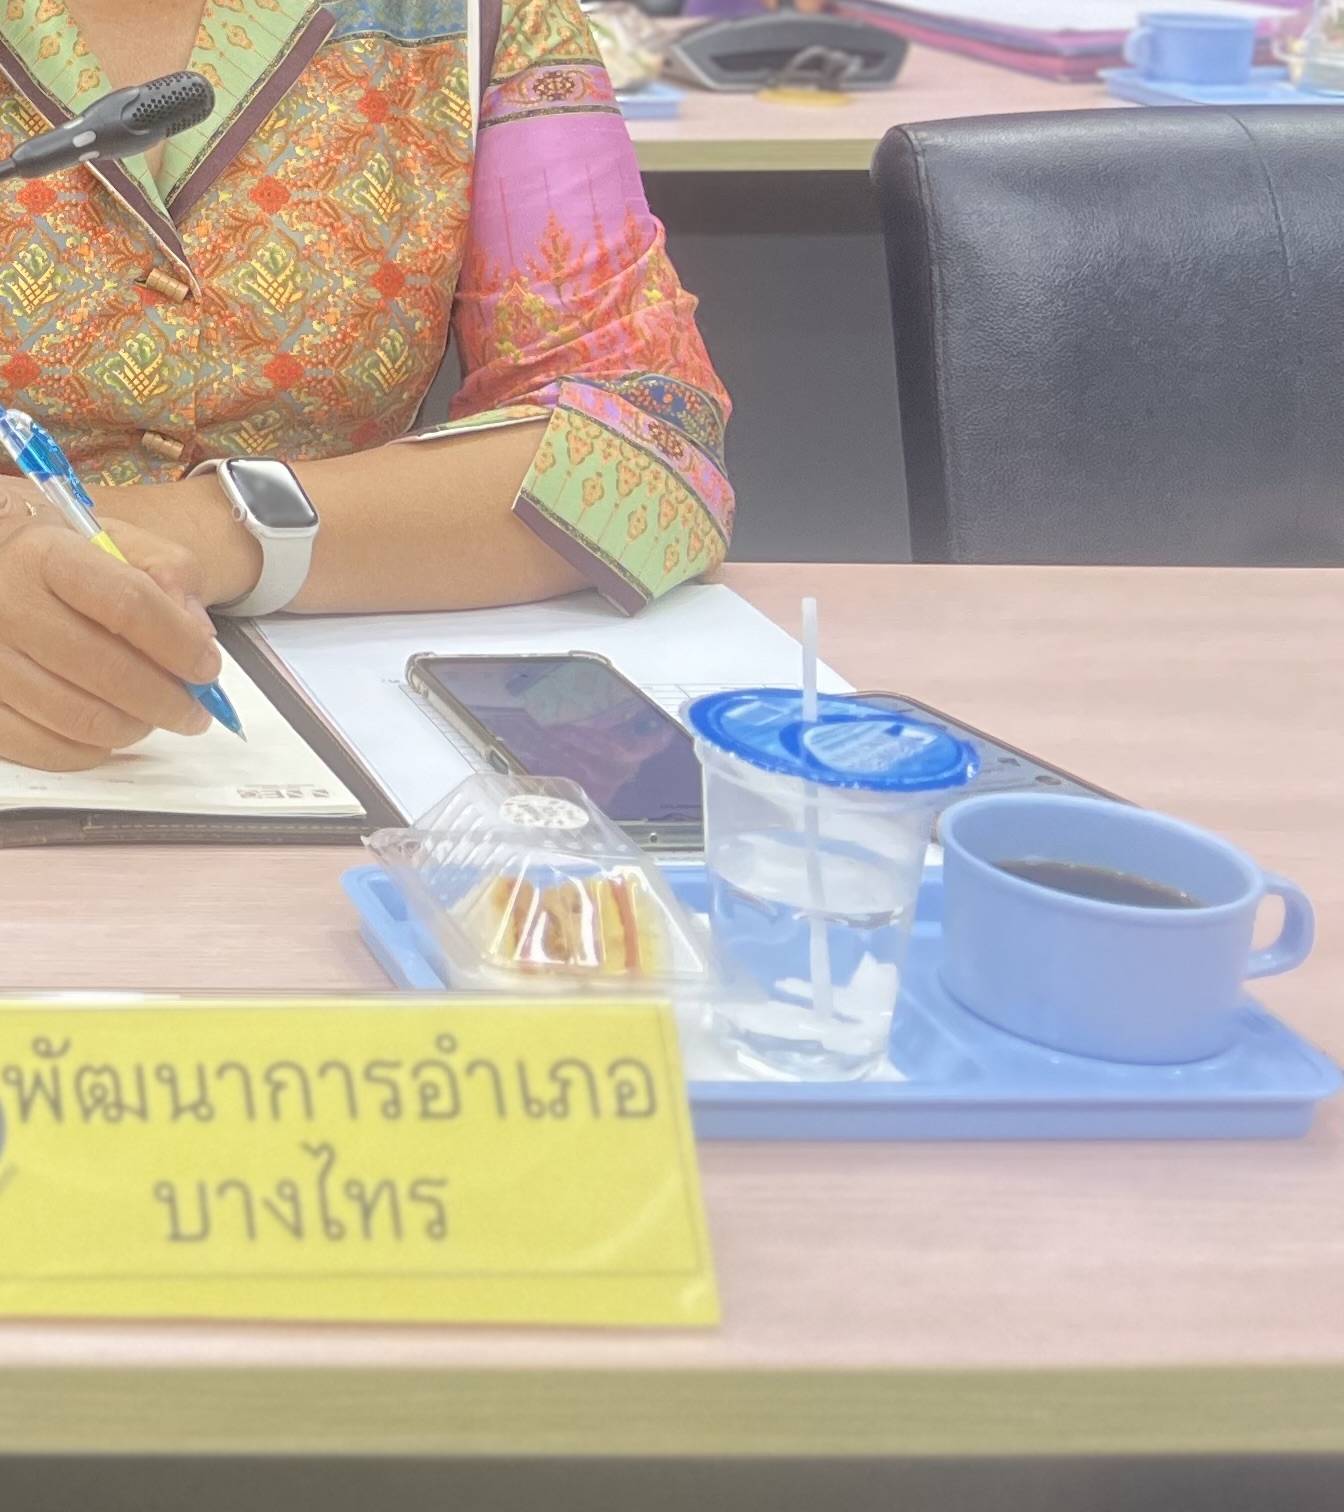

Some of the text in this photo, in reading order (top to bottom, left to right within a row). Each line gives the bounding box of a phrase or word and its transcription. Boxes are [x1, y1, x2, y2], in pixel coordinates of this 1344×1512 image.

[1, 1033, 659, 1127] พัฒนาการอำเภอ
[152, 1141, 451, 1243] บางไทร
